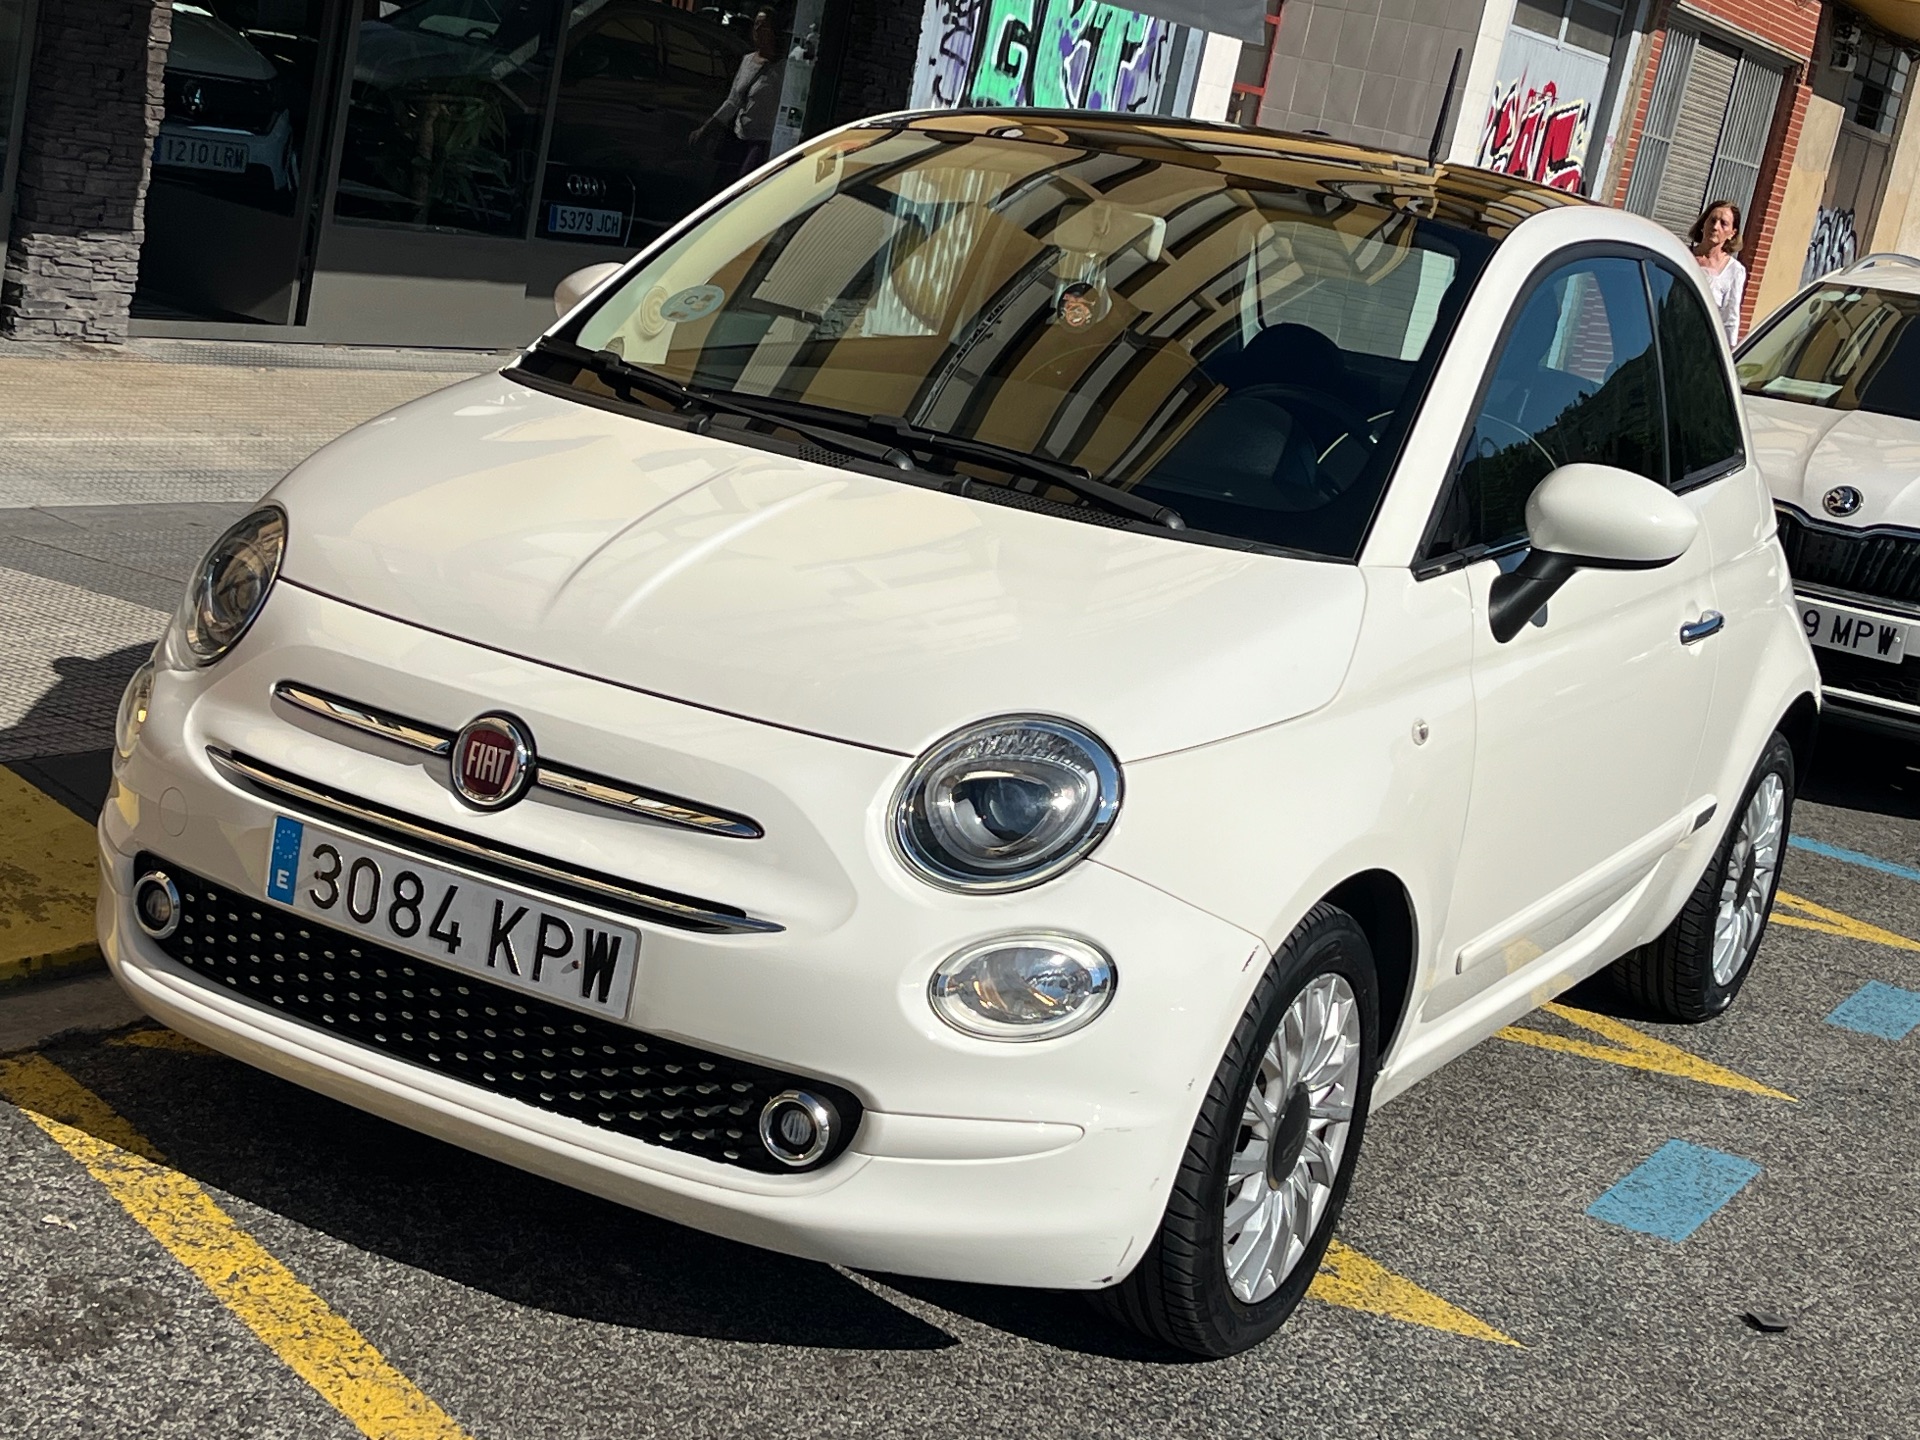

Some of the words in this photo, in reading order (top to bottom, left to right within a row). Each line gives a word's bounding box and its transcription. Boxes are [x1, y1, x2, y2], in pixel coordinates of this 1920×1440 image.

[167, 139, 209, 163] 1210
[559, 209, 593, 231] 5379
[596, 213, 619, 234] JCH
[1803, 610, 1820, 637] 9
[1830, 615, 1897, 655] MPW
[466, 740, 511, 785] FIAT
[276, 869, 290, 890] E
[309, 843, 462, 955] 3084
[487, 898, 622, 1004] KPW
